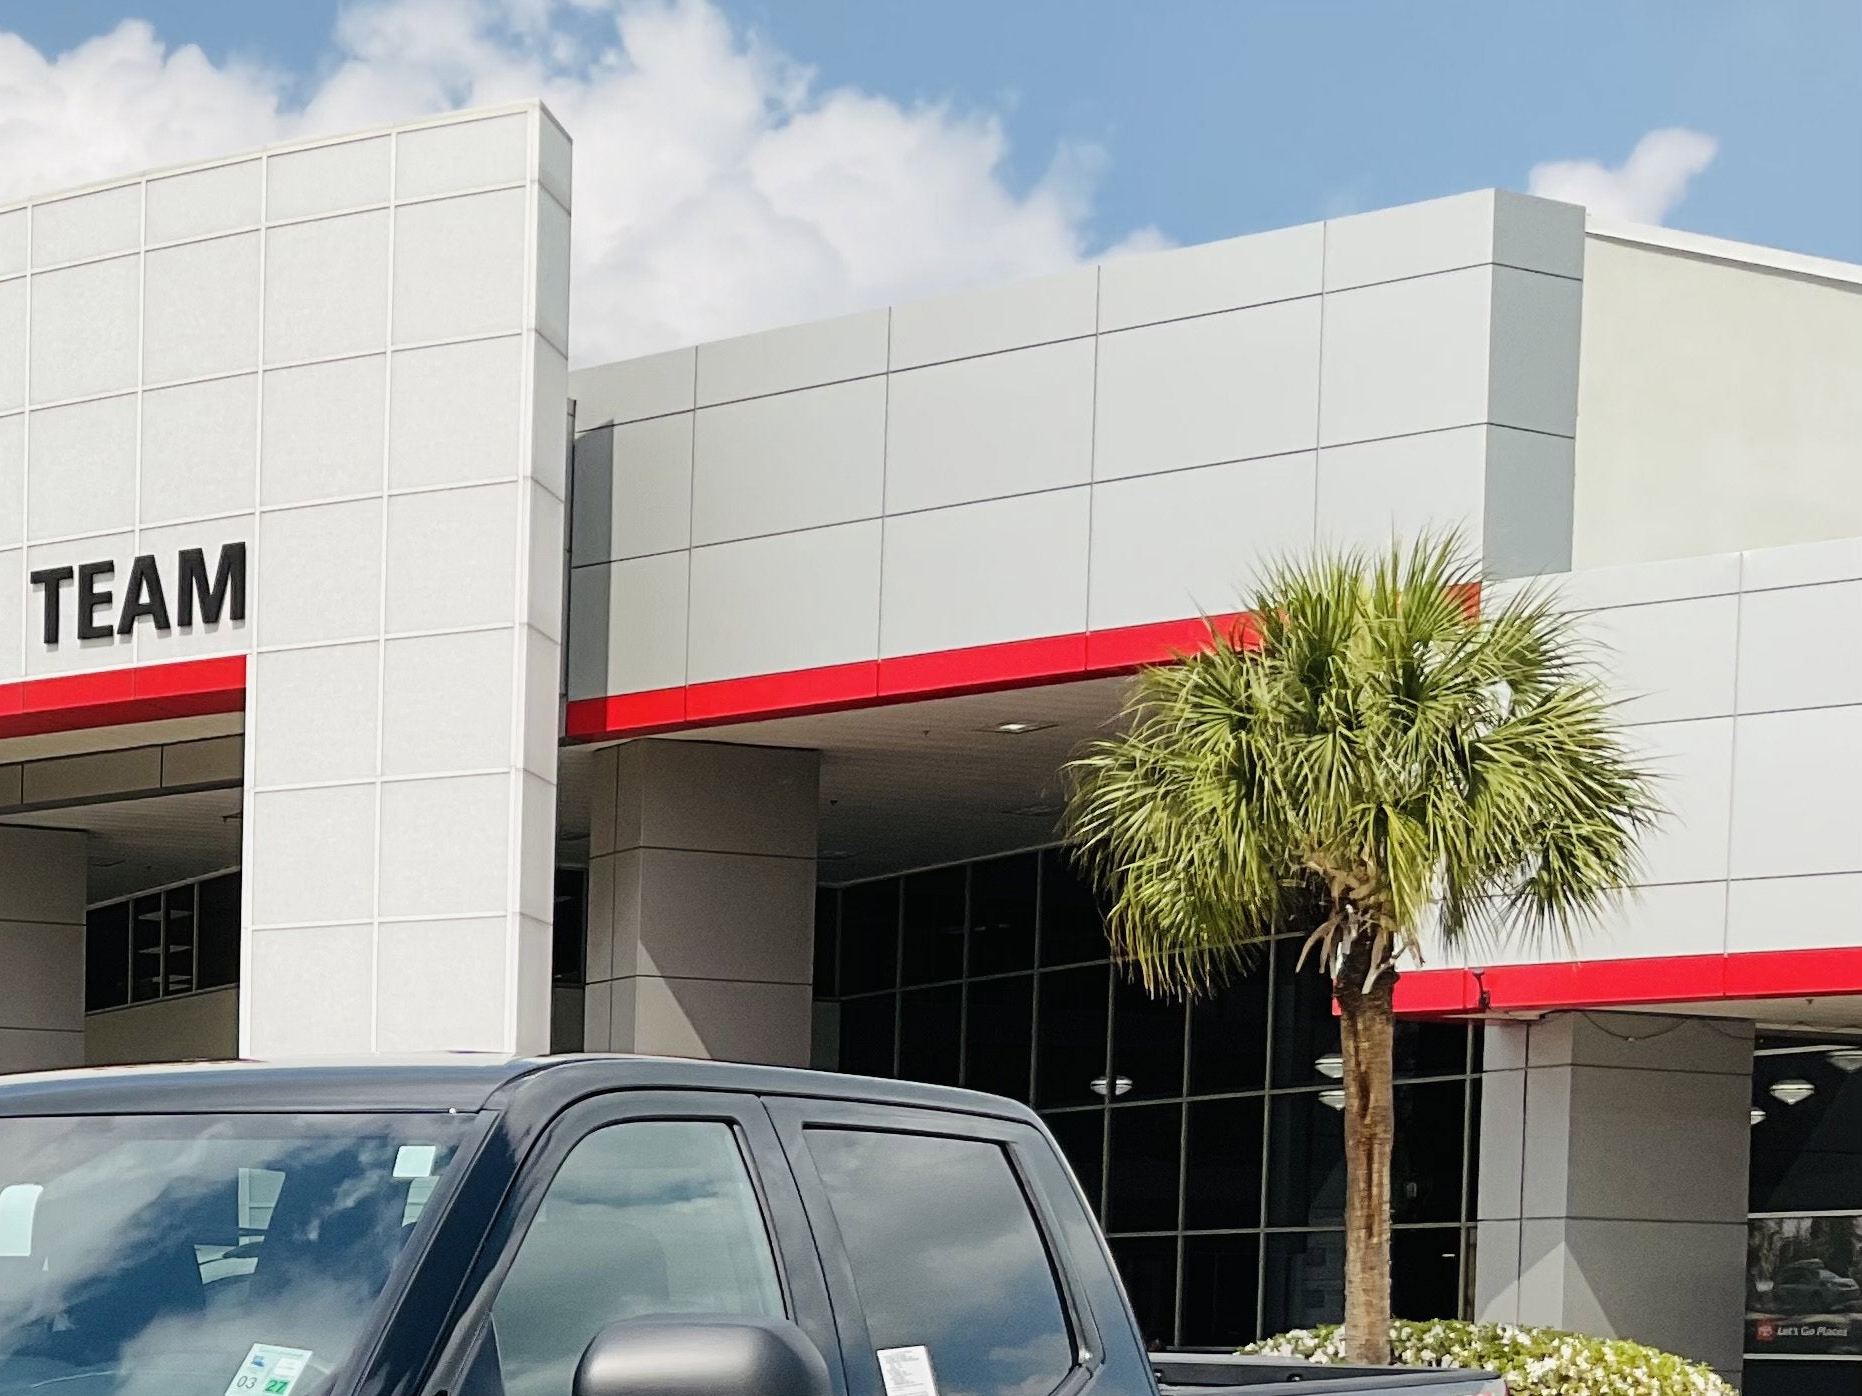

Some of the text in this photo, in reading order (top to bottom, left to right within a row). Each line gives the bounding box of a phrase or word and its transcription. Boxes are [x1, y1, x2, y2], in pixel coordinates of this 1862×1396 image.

[30, 541, 246, 644] TEAM
[1800, 1325, 1816, 1336] Go
[237, 1375, 290, 1393] 03 27
